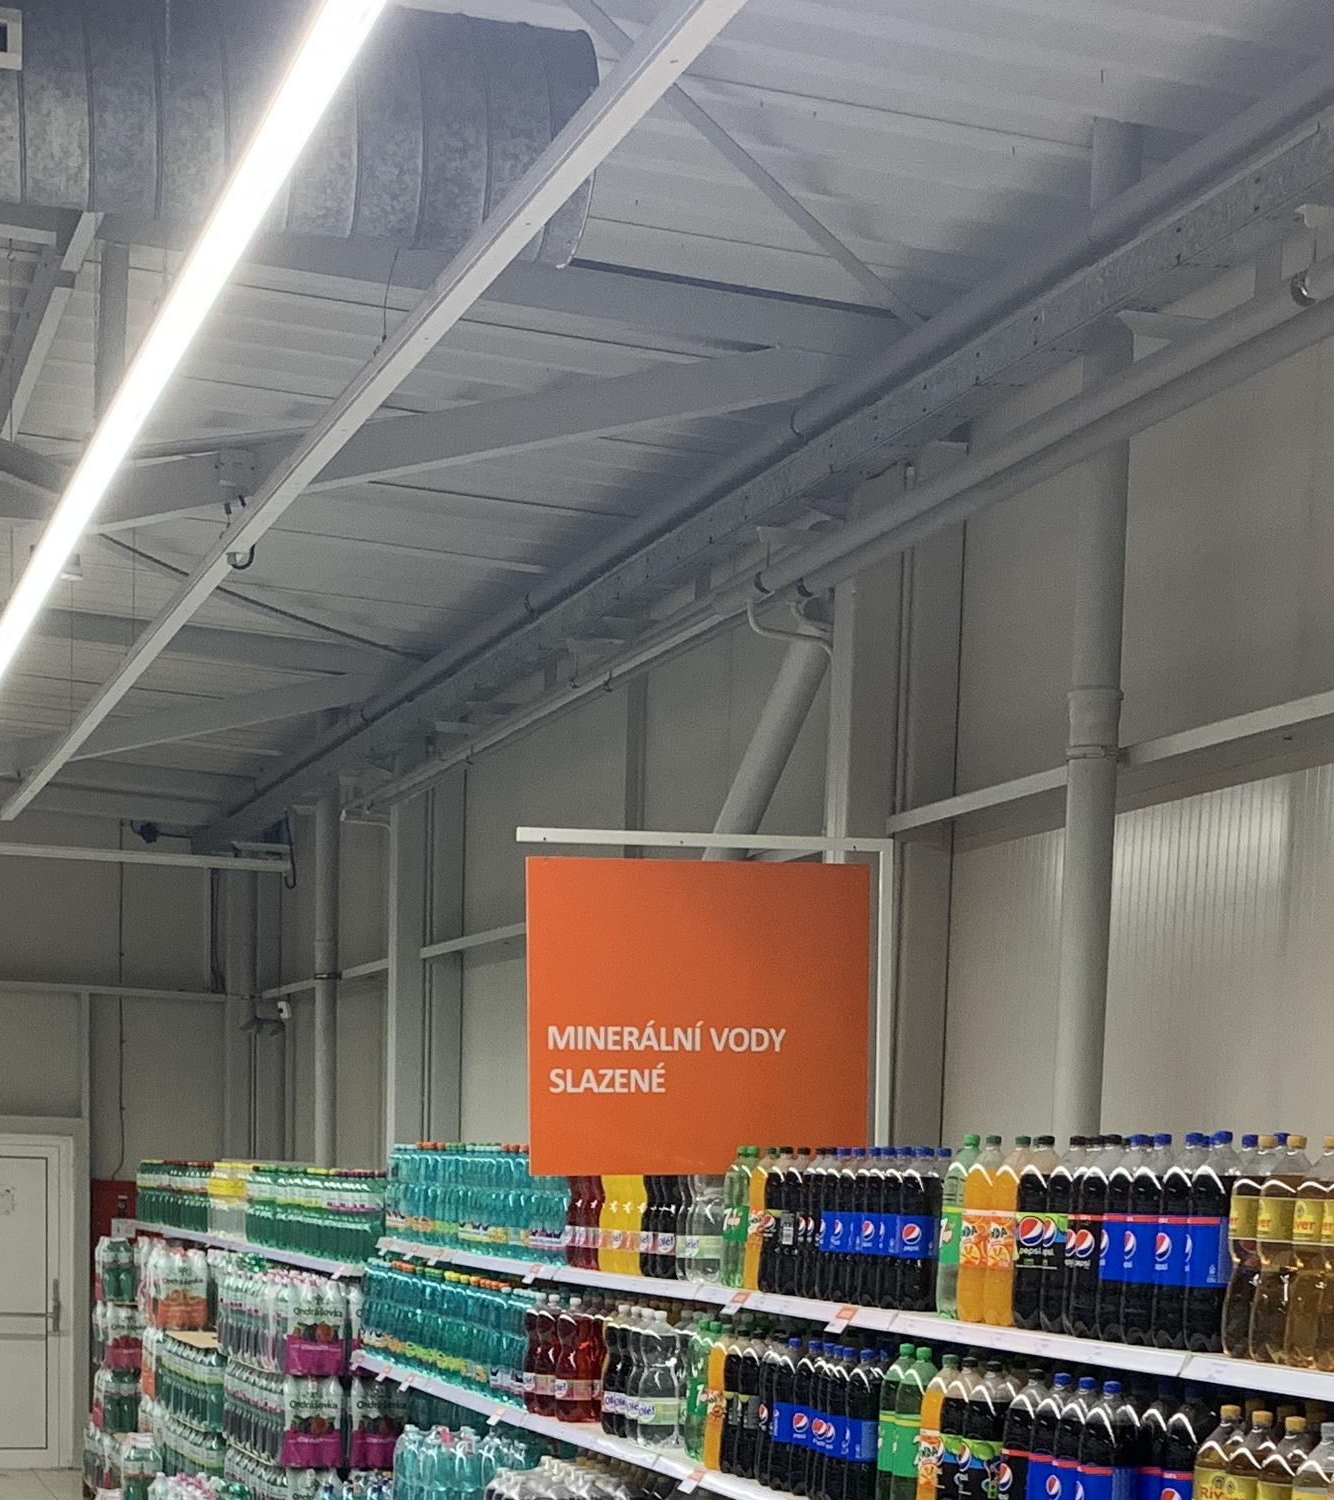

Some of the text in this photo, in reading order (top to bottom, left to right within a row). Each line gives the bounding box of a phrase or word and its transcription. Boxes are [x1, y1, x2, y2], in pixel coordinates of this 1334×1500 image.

[547, 1020, 786, 1052] MINERÁLNÍ VODY
[549, 1062, 666, 1093] SLAZENÉ
